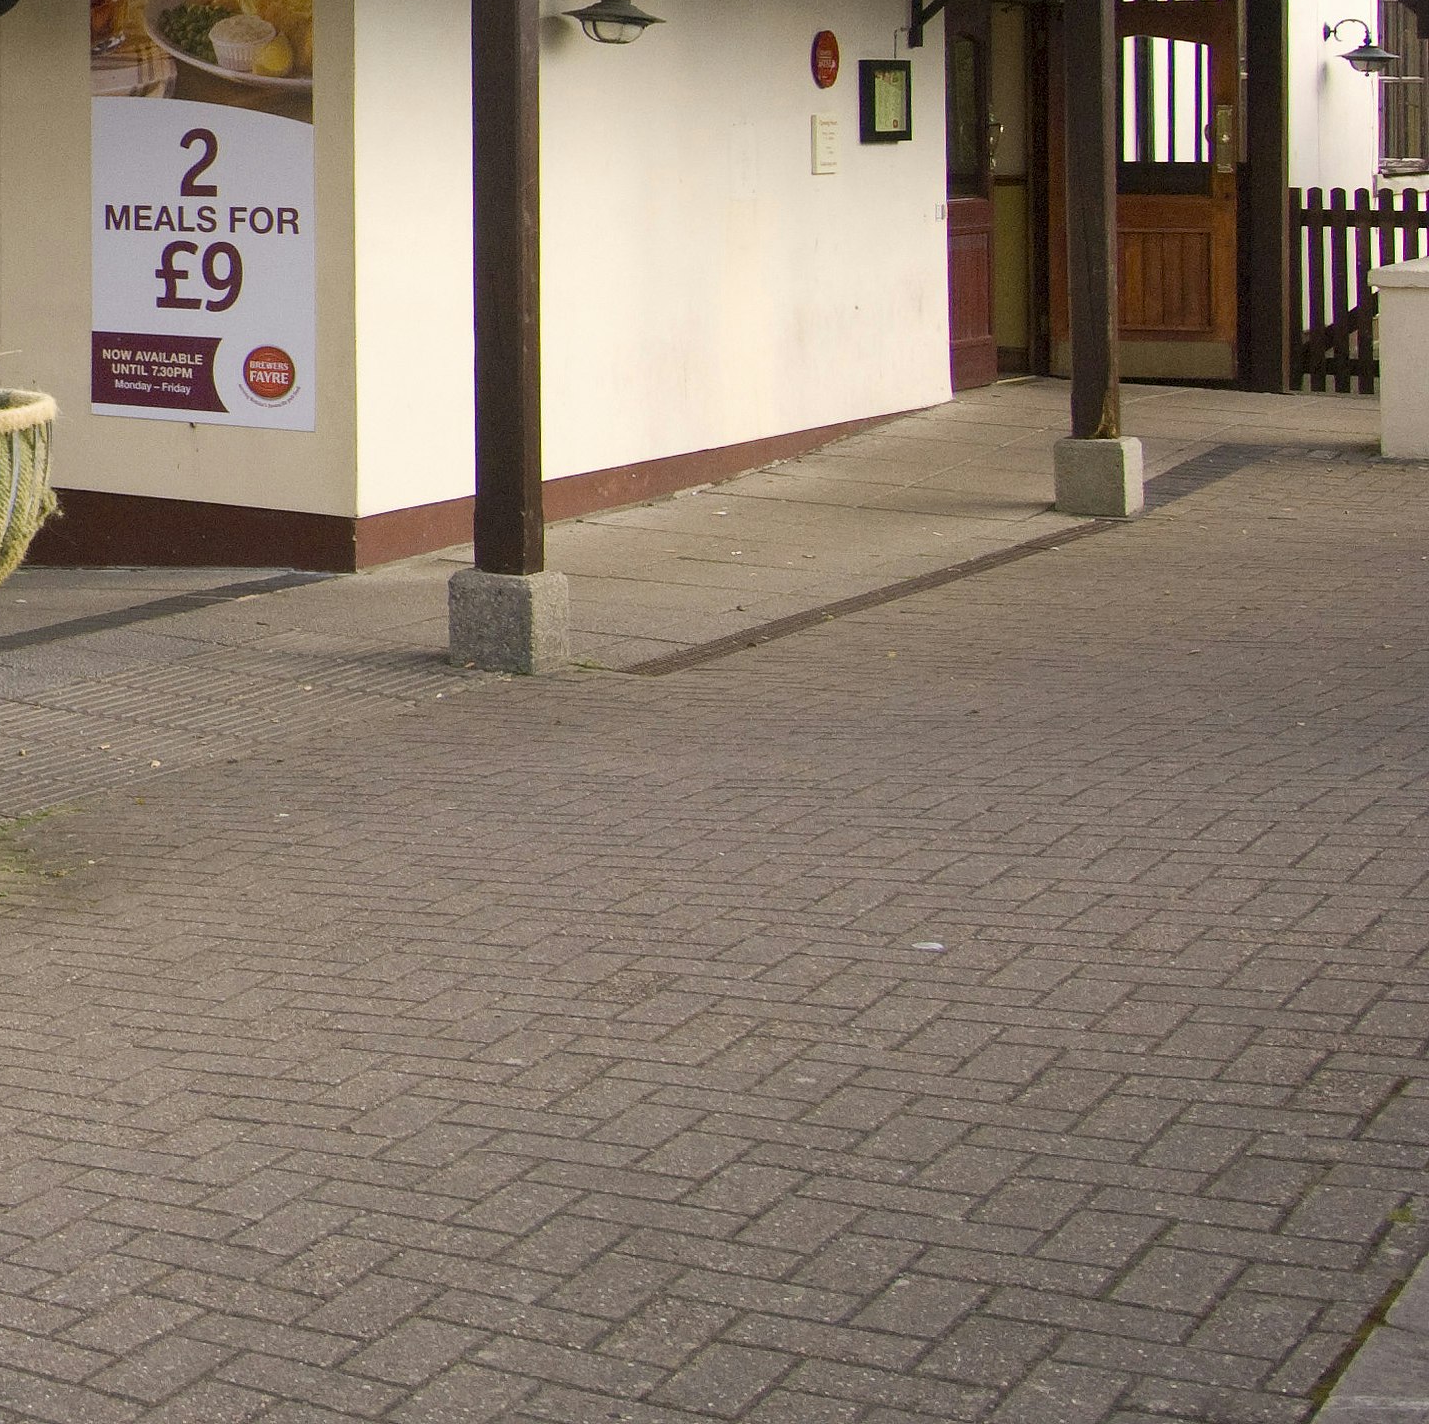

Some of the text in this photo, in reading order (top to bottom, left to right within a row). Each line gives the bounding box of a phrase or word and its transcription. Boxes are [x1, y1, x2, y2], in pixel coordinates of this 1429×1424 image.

[179, 128, 218, 197] 2
[104, 204, 300, 235] MEALS FOR
[154, 240, 243, 312] £9
[102, 349, 203, 365] NOW AVAILABLE
[112, 363, 193, 379] UNTIL 7.30PM
[249, 360, 289, 371] BREWERS
[249, 370, 289, 385] FAYRE
[114, 379, 152, 392] Monday
[162, 382, 191, 395] Friday
